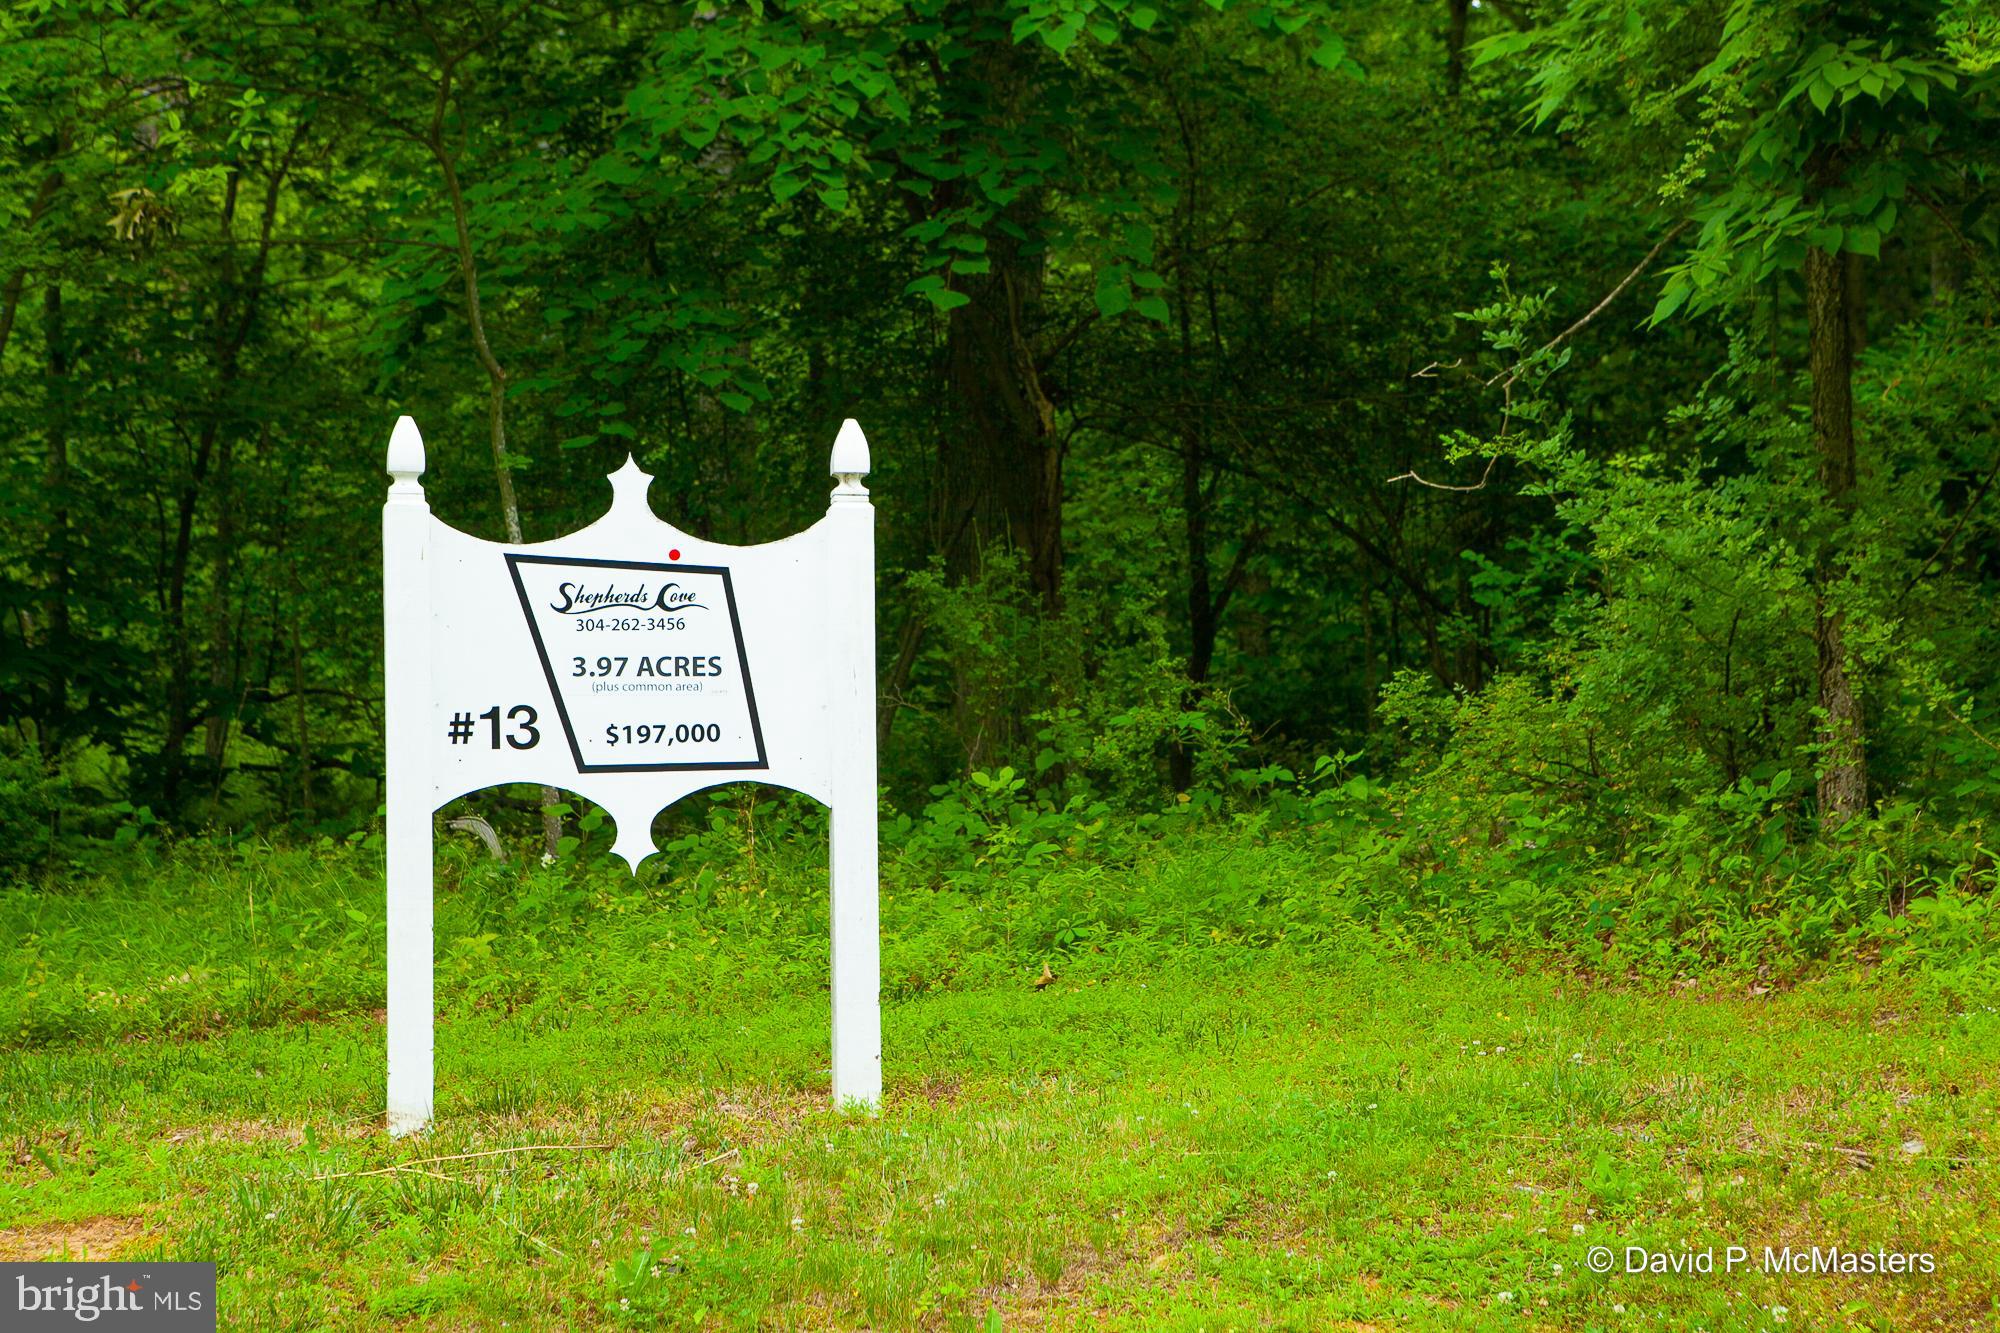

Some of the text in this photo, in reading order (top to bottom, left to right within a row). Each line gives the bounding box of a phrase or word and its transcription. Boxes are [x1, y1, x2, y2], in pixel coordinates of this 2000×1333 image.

[550, 582, 709, 614] Shepherds Cove
[576, 618, 685, 631] 304-262-3456
[572, 657, 722, 677] 3.97 ACRES
[592, 682, 618, 693] (plus
[622, 683, 672, 691] common
[676, 682, 703, 692] area)
[448, 705, 540, 750] #13
[606, 723, 721, 747] $197,000
